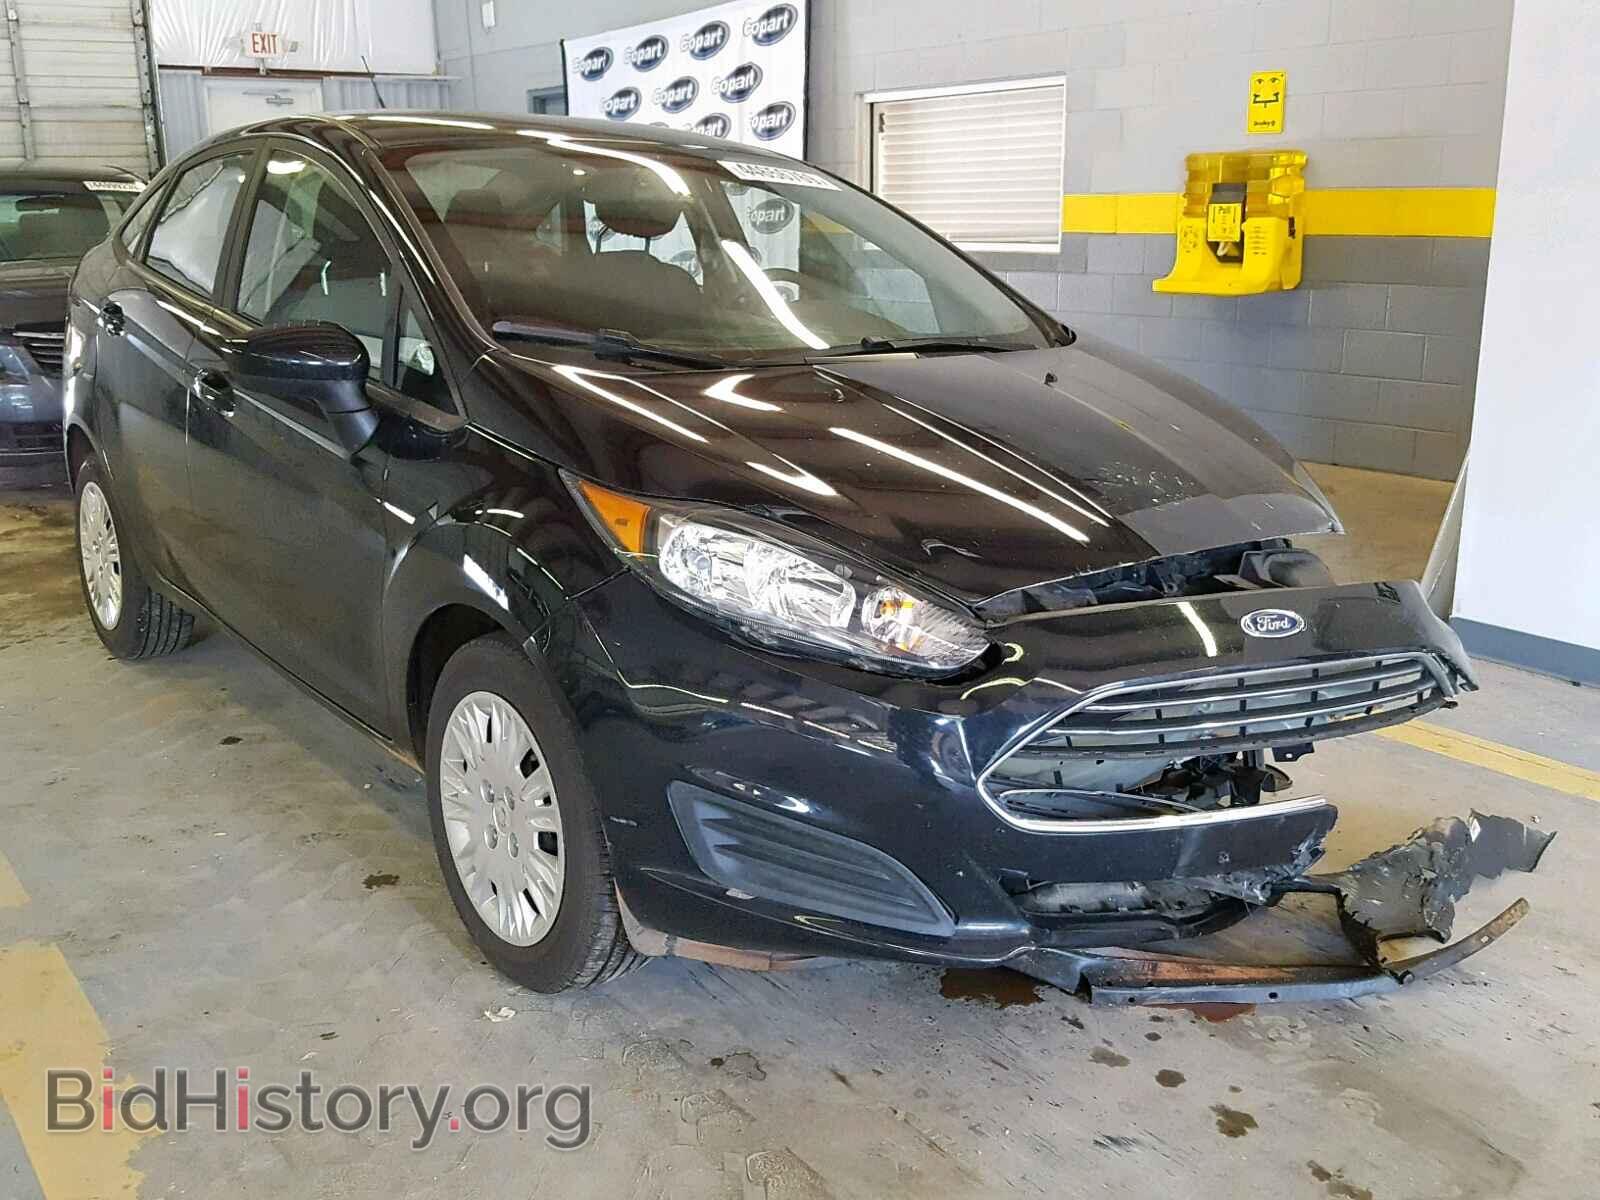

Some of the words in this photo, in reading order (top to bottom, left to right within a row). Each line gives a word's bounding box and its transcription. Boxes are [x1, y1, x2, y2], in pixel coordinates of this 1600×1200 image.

[743, 8, 788, 39] Copart
[252, 33, 277, 54] EXIT
[1257, 615, 1291, 631] Ford
